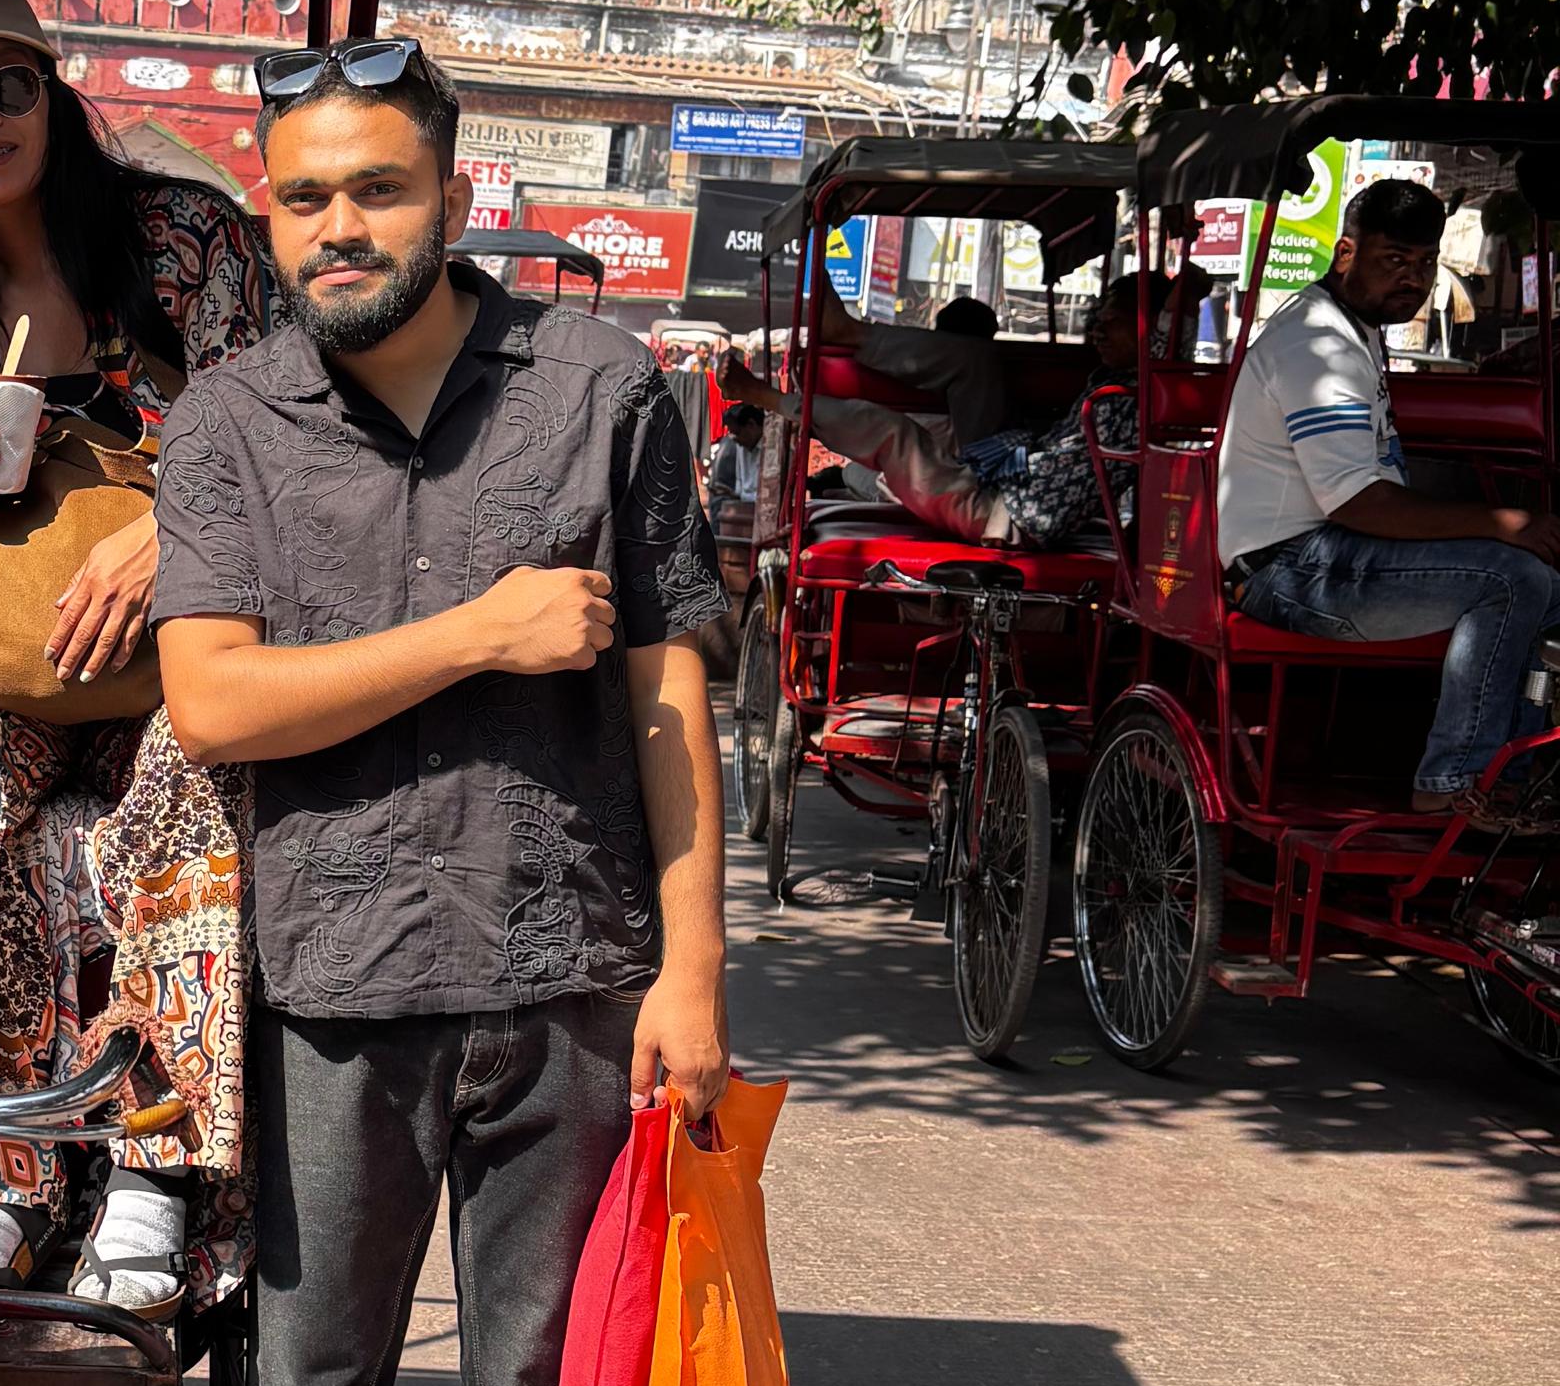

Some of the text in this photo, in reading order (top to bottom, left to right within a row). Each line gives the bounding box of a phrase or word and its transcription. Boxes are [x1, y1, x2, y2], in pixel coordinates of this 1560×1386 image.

[459, 121, 545, 146] RIJBASI
[565, 232, 663, 257] AHORE
[622, 256, 670, 270] STORE
[1268, 248, 1313, 264] Reuse
[1262, 264, 1317, 283] Recycle
